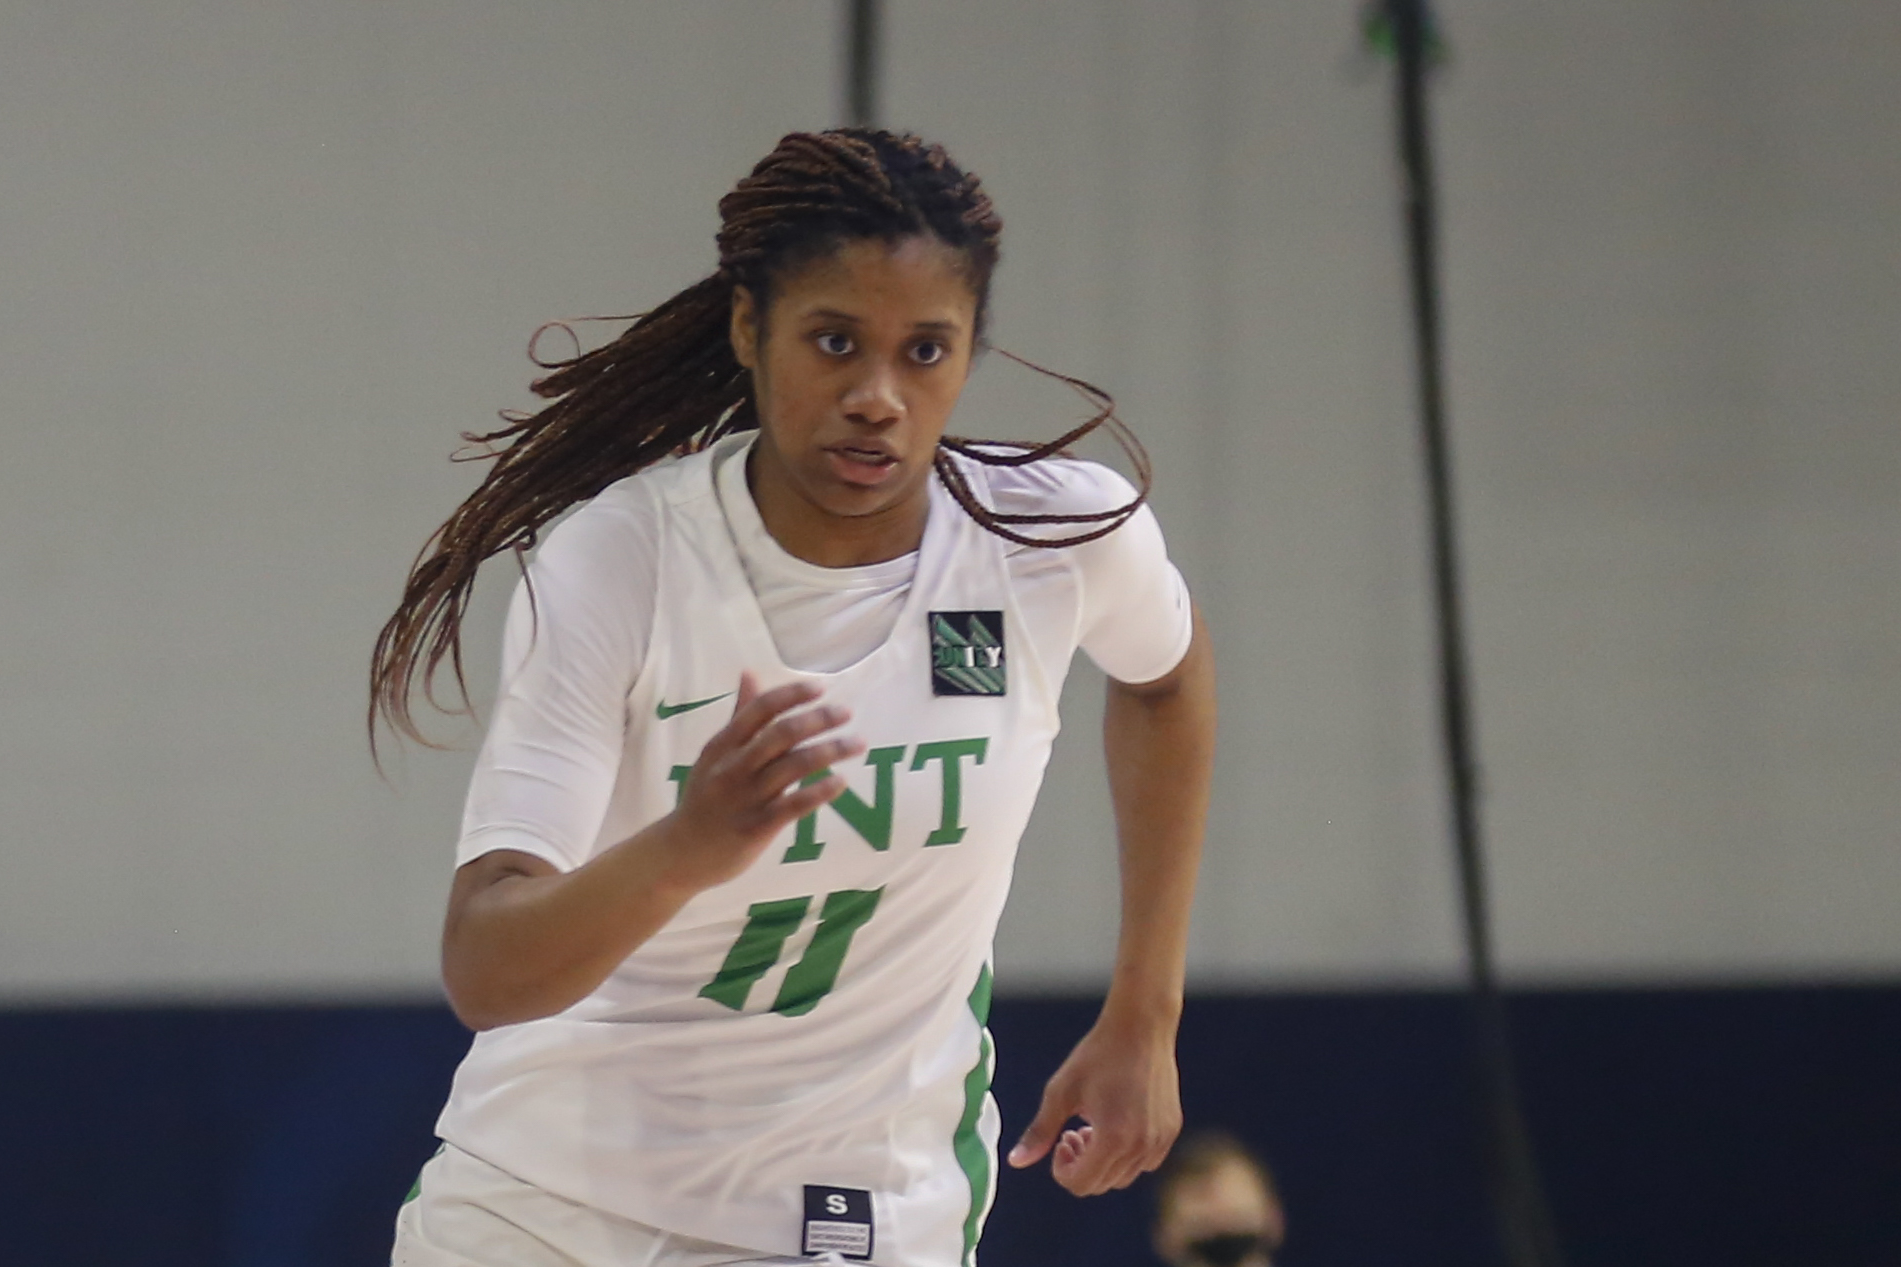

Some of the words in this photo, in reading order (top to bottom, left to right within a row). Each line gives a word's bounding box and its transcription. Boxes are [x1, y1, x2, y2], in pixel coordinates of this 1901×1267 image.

[667, 737, 991, 864] NT
[697, 884, 888, 1018] 11
[825, 1194, 849, 1215] S
